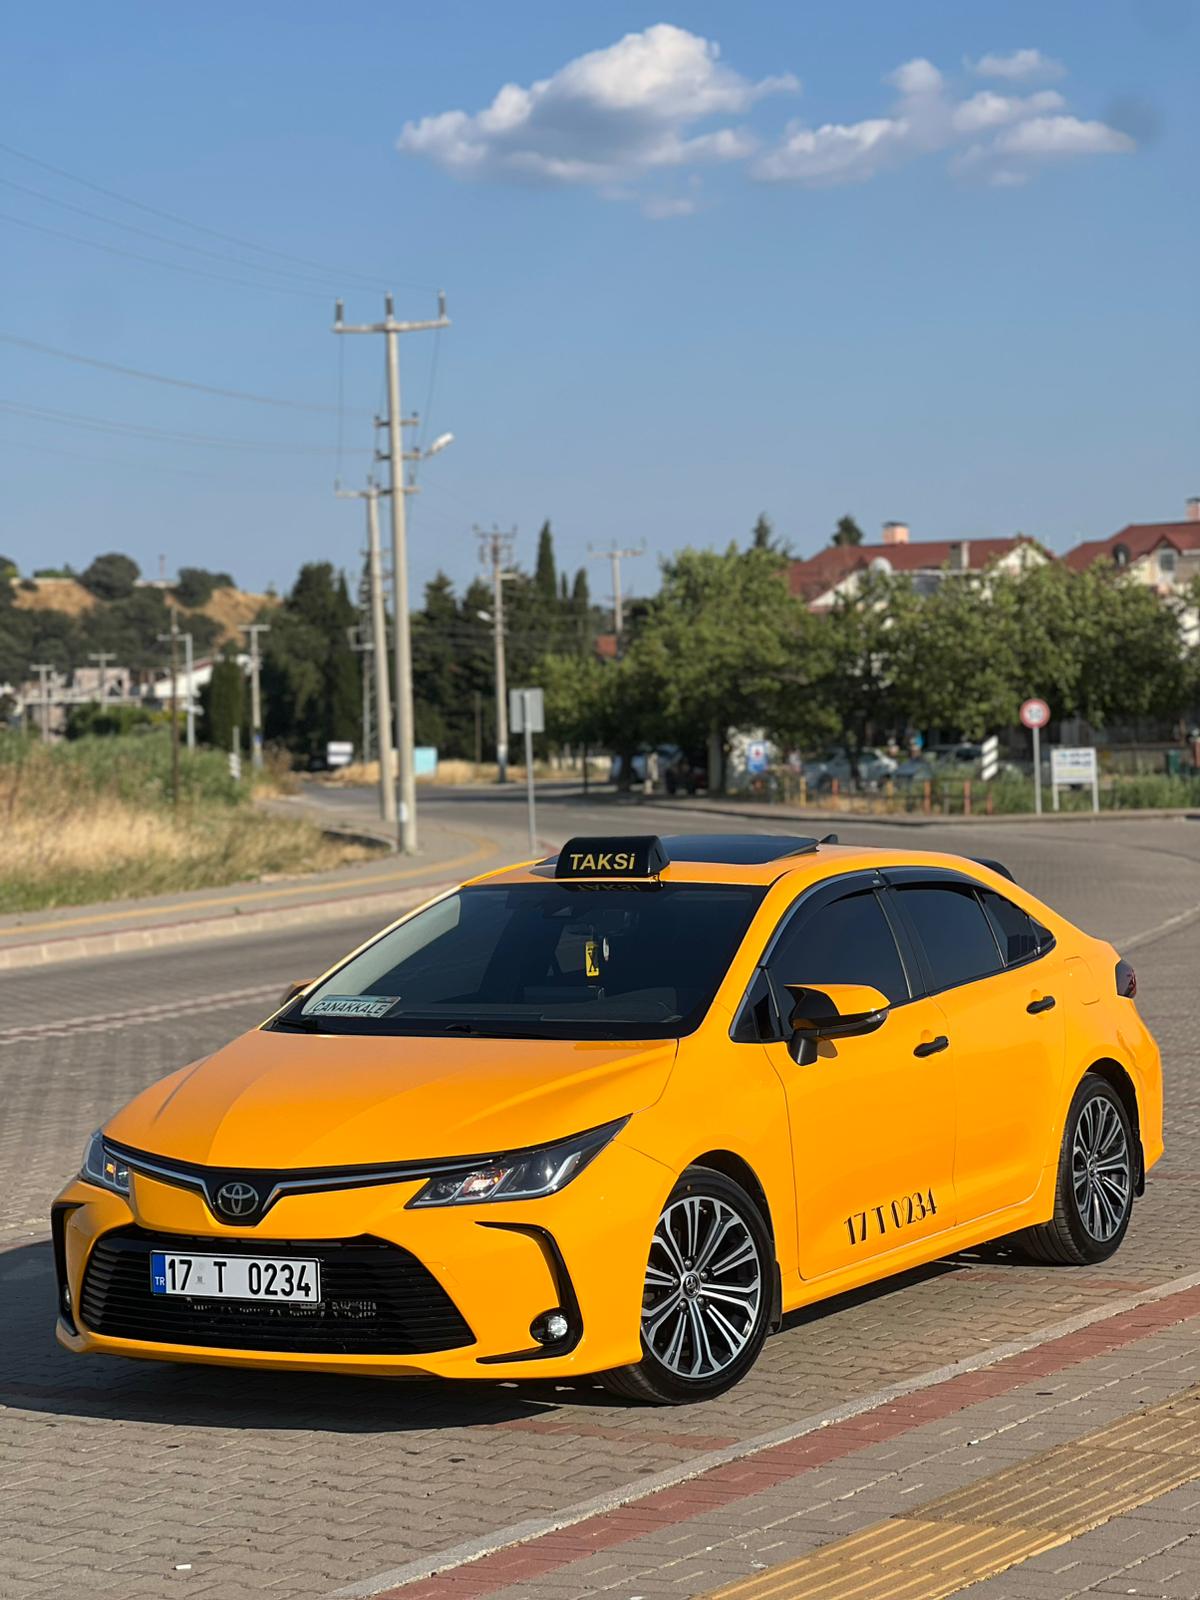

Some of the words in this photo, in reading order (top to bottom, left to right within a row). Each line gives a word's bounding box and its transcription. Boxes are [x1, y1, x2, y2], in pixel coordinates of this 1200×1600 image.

[843, 1211, 867, 1245] 17
[871, 1205, 886, 1235] T
[891, 1188, 937, 1229] 0234
[155, 1276, 166, 1287] TR
[168, 1259, 192, 1291] 17
[214, 1261, 227, 1293] T
[249, 1263, 311, 1297] 0234
